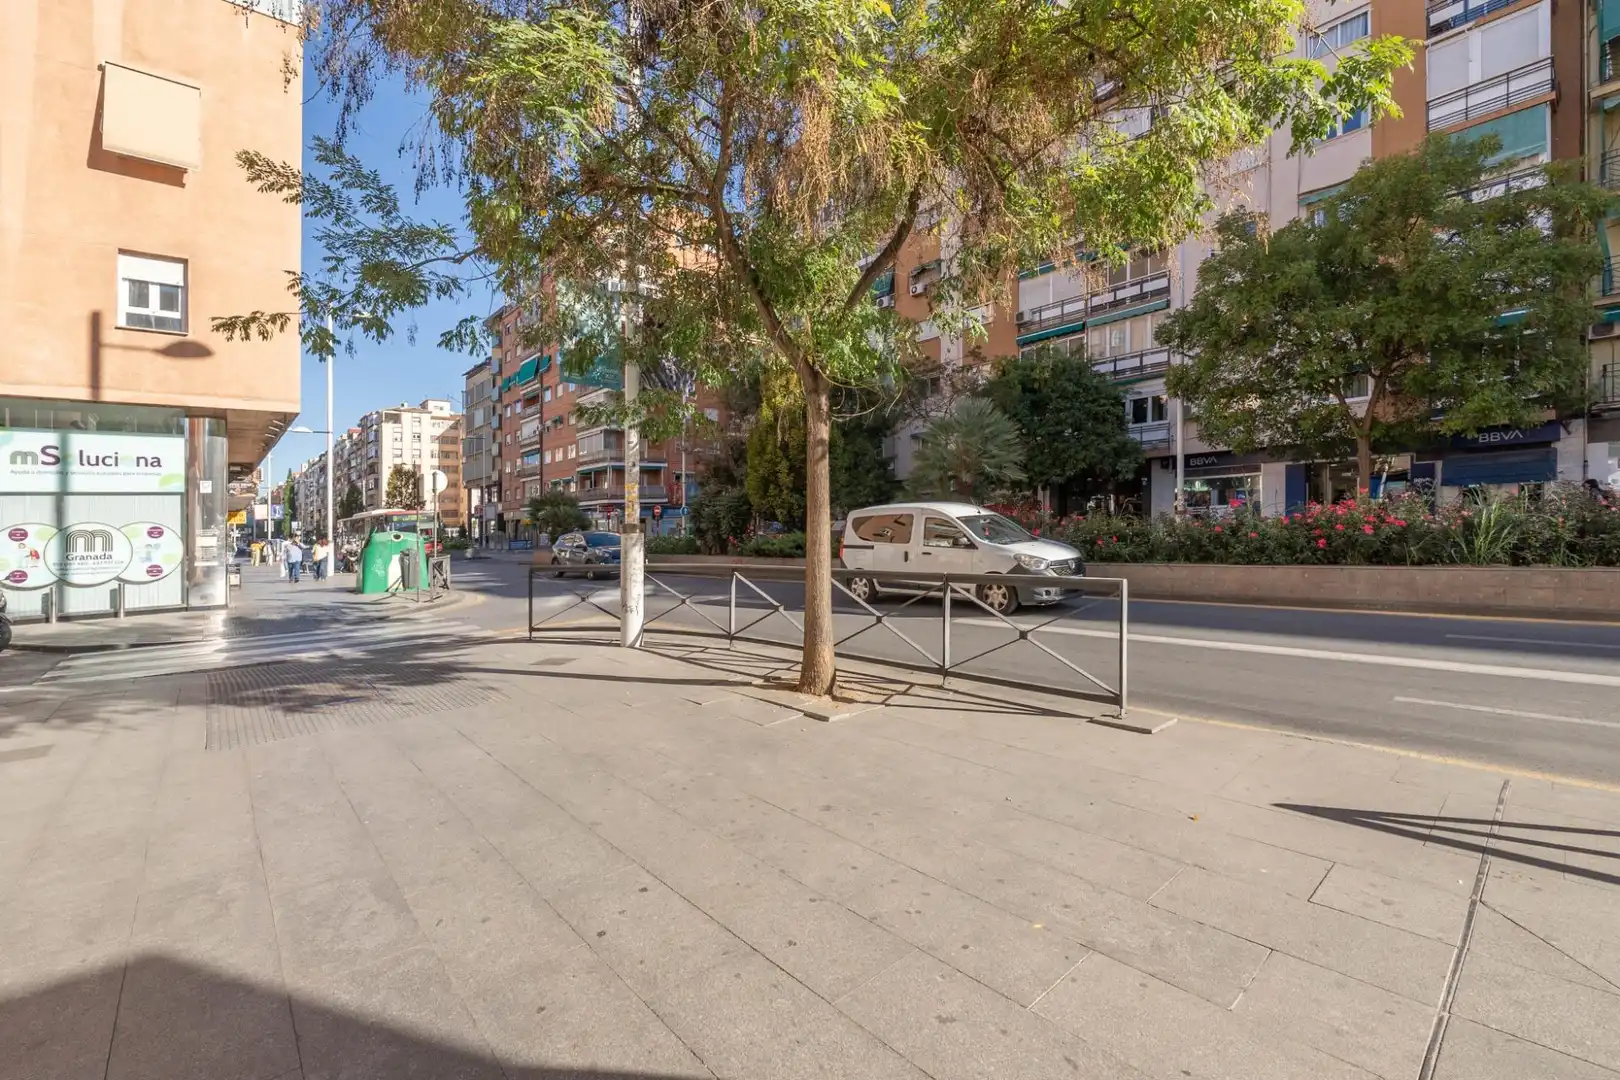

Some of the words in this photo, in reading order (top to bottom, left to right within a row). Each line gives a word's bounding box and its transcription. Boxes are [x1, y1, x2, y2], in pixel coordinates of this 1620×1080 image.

[1478, 430, 1524, 443] BBVA
[10, 445, 162, 467] mSlucina
[1189, 455, 1218, 466] BBVA
[66, 553, 113, 561] Granada
